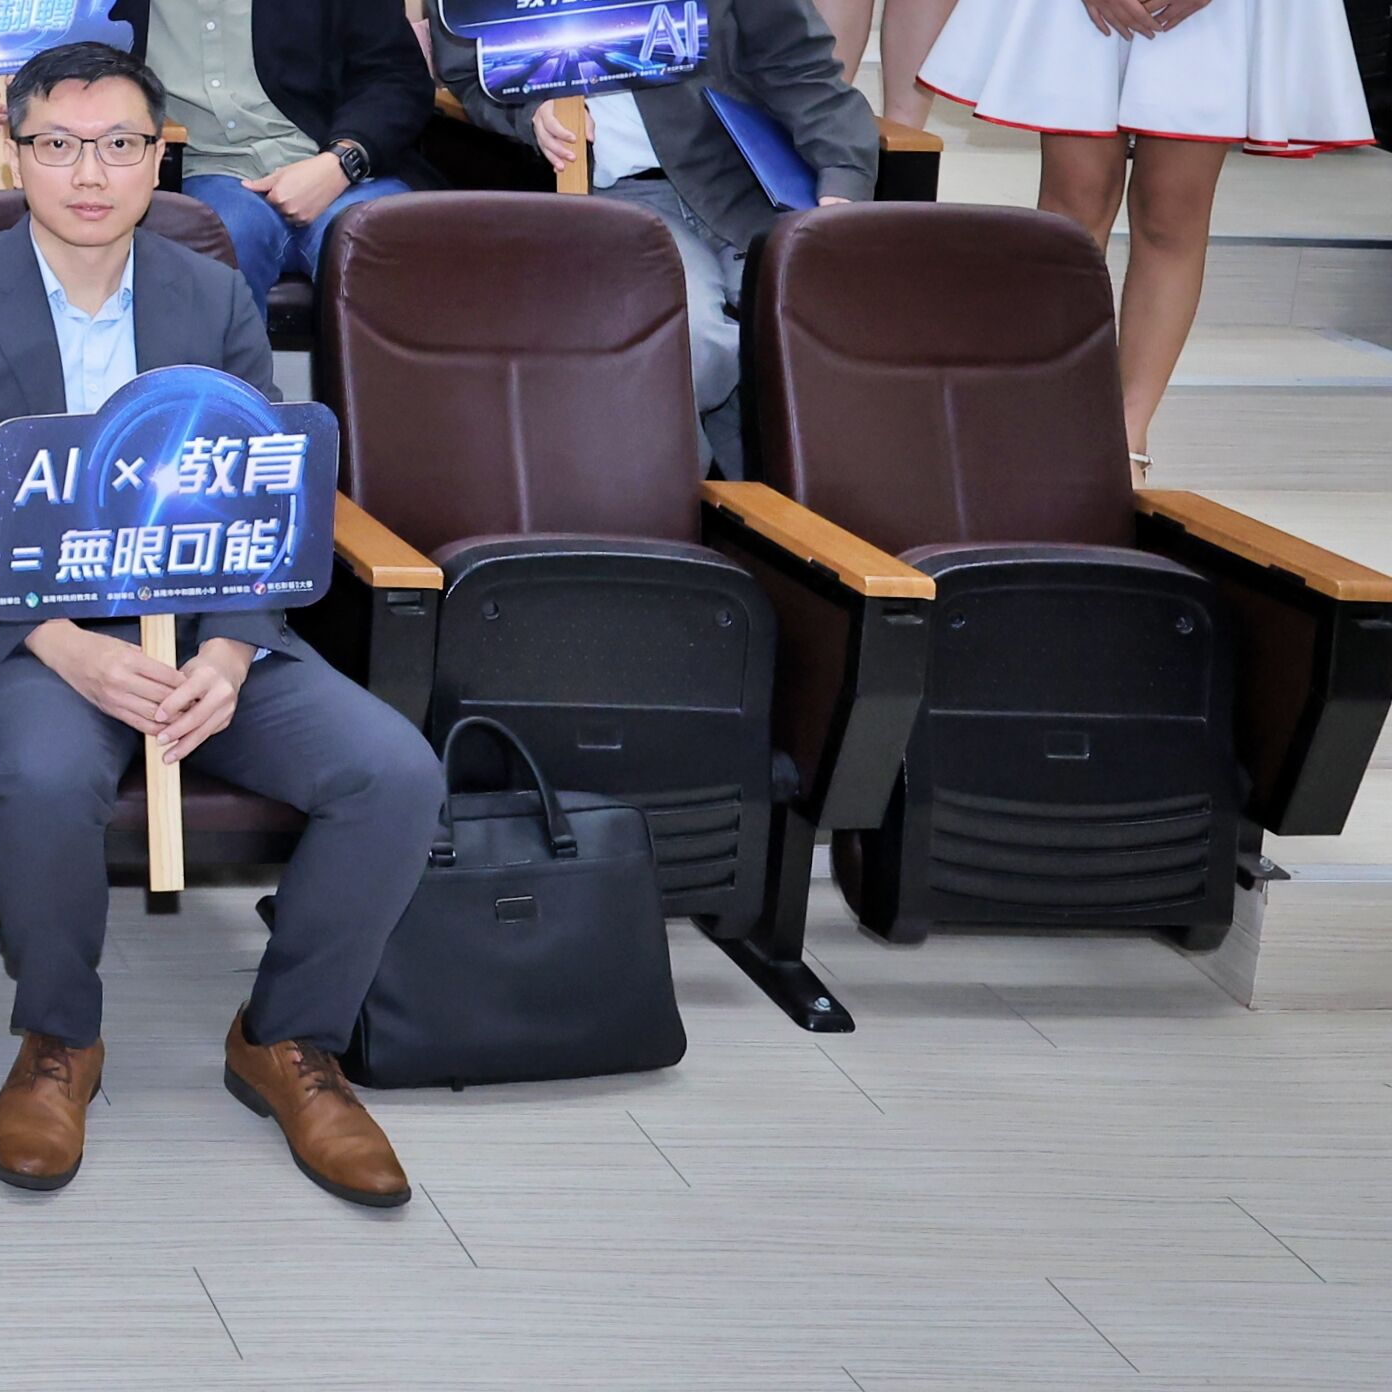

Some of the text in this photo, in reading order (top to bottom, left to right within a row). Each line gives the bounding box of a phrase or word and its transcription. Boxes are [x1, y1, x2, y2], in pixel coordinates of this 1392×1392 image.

[639, 0, 700, 62] AI
[13, 447, 83, 506] AI
[177, 433, 310, 497] 教育
[222, 585, 250, 595] 辦單位
[267, 580, 313, 590] 崇右影藝大學
